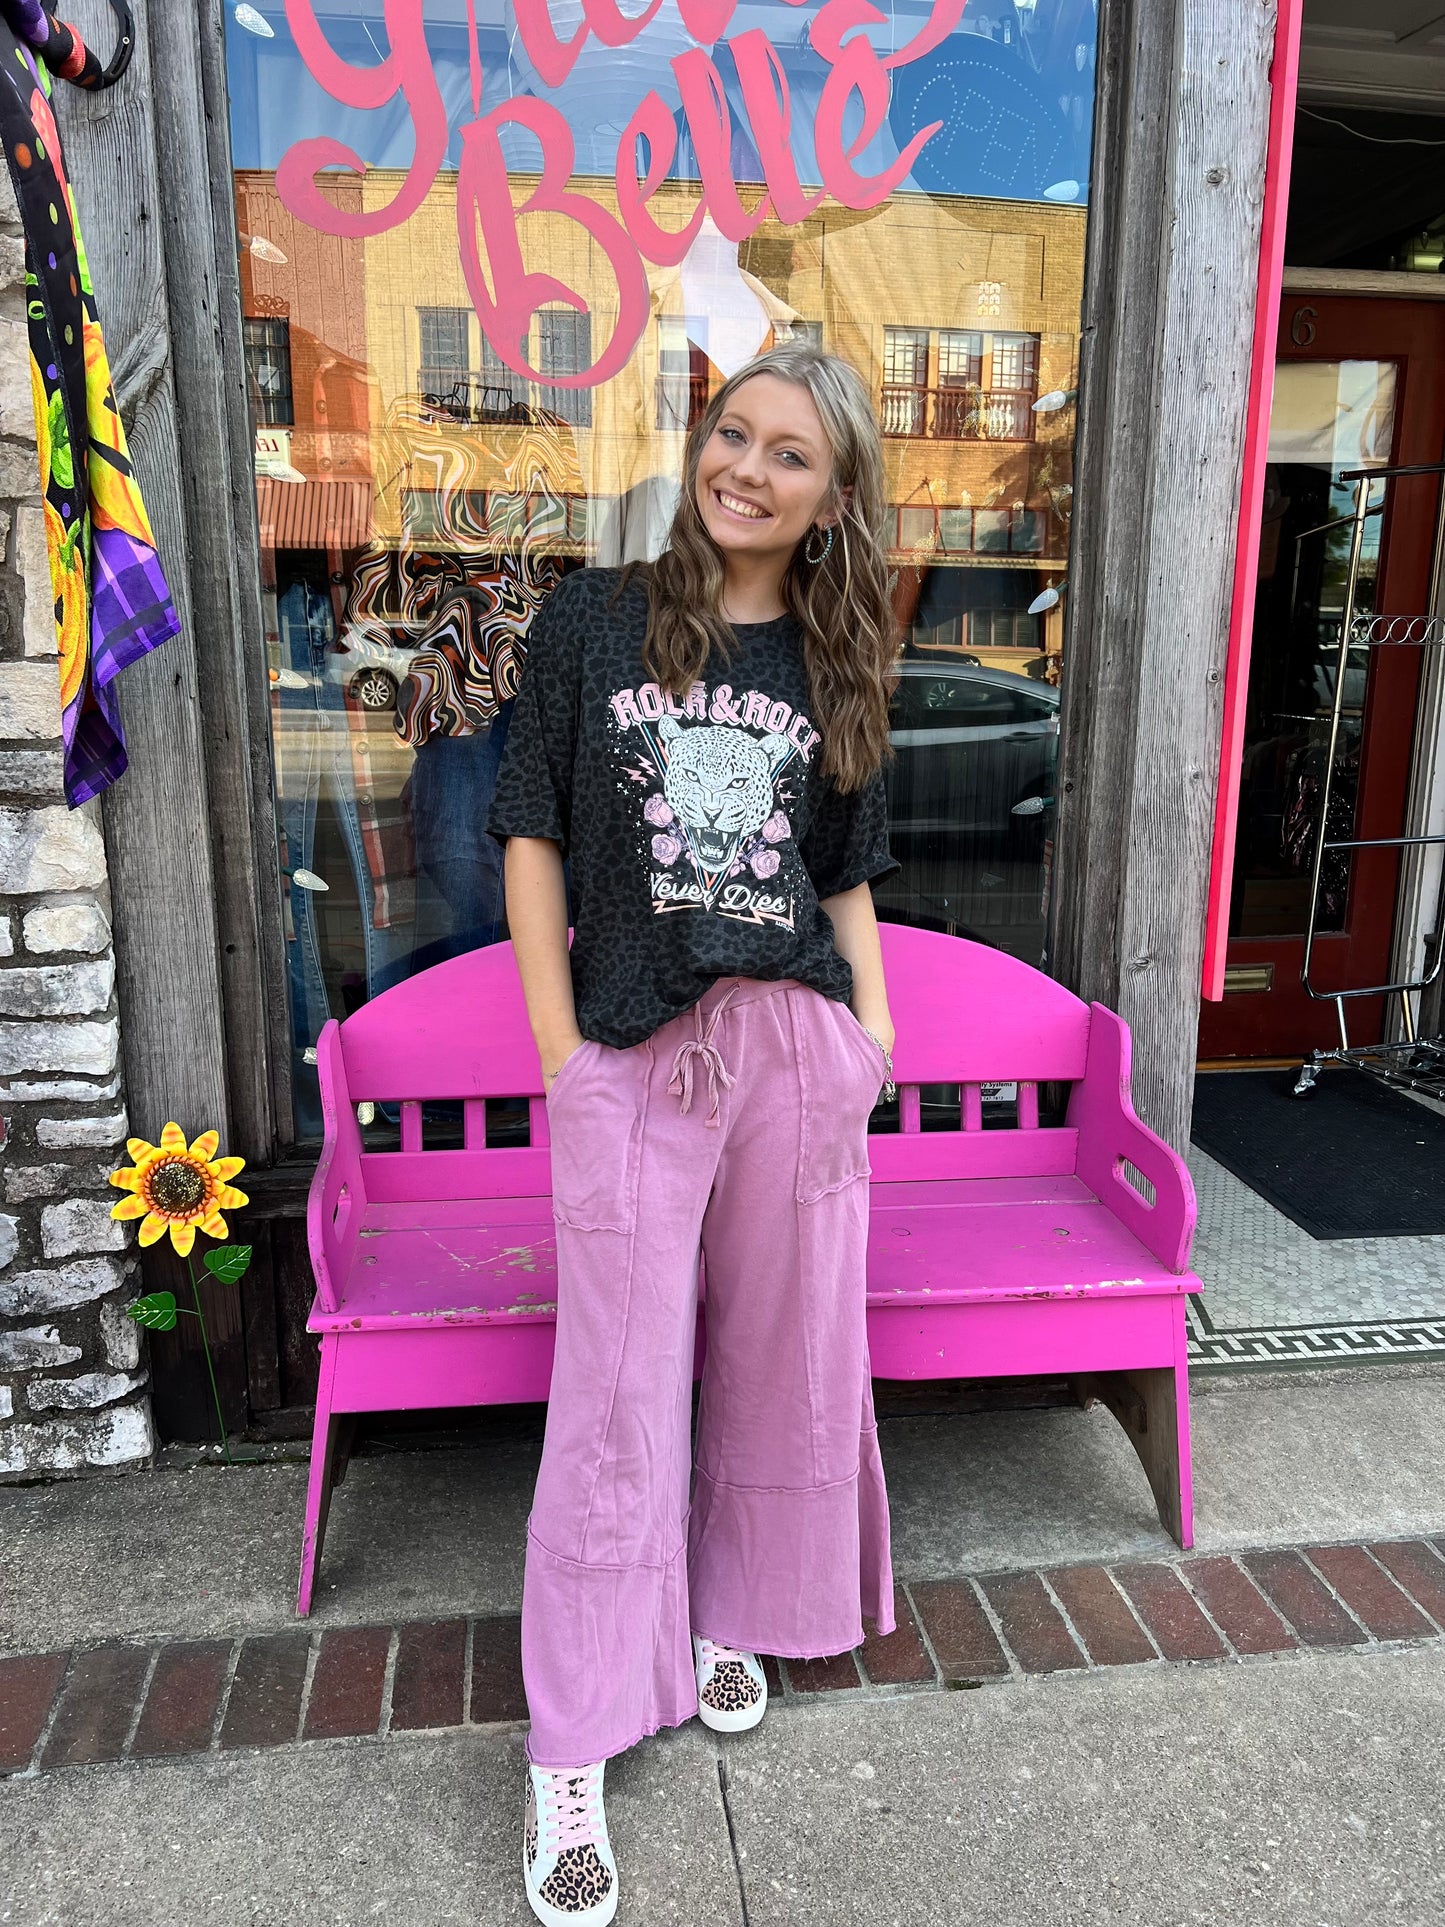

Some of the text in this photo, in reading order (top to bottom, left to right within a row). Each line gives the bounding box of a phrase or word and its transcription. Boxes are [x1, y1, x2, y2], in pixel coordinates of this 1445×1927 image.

[457, 27, 944, 390] Belle
[1291, 306, 1319, 346] 6
[718, 883, 788, 914] Dies
